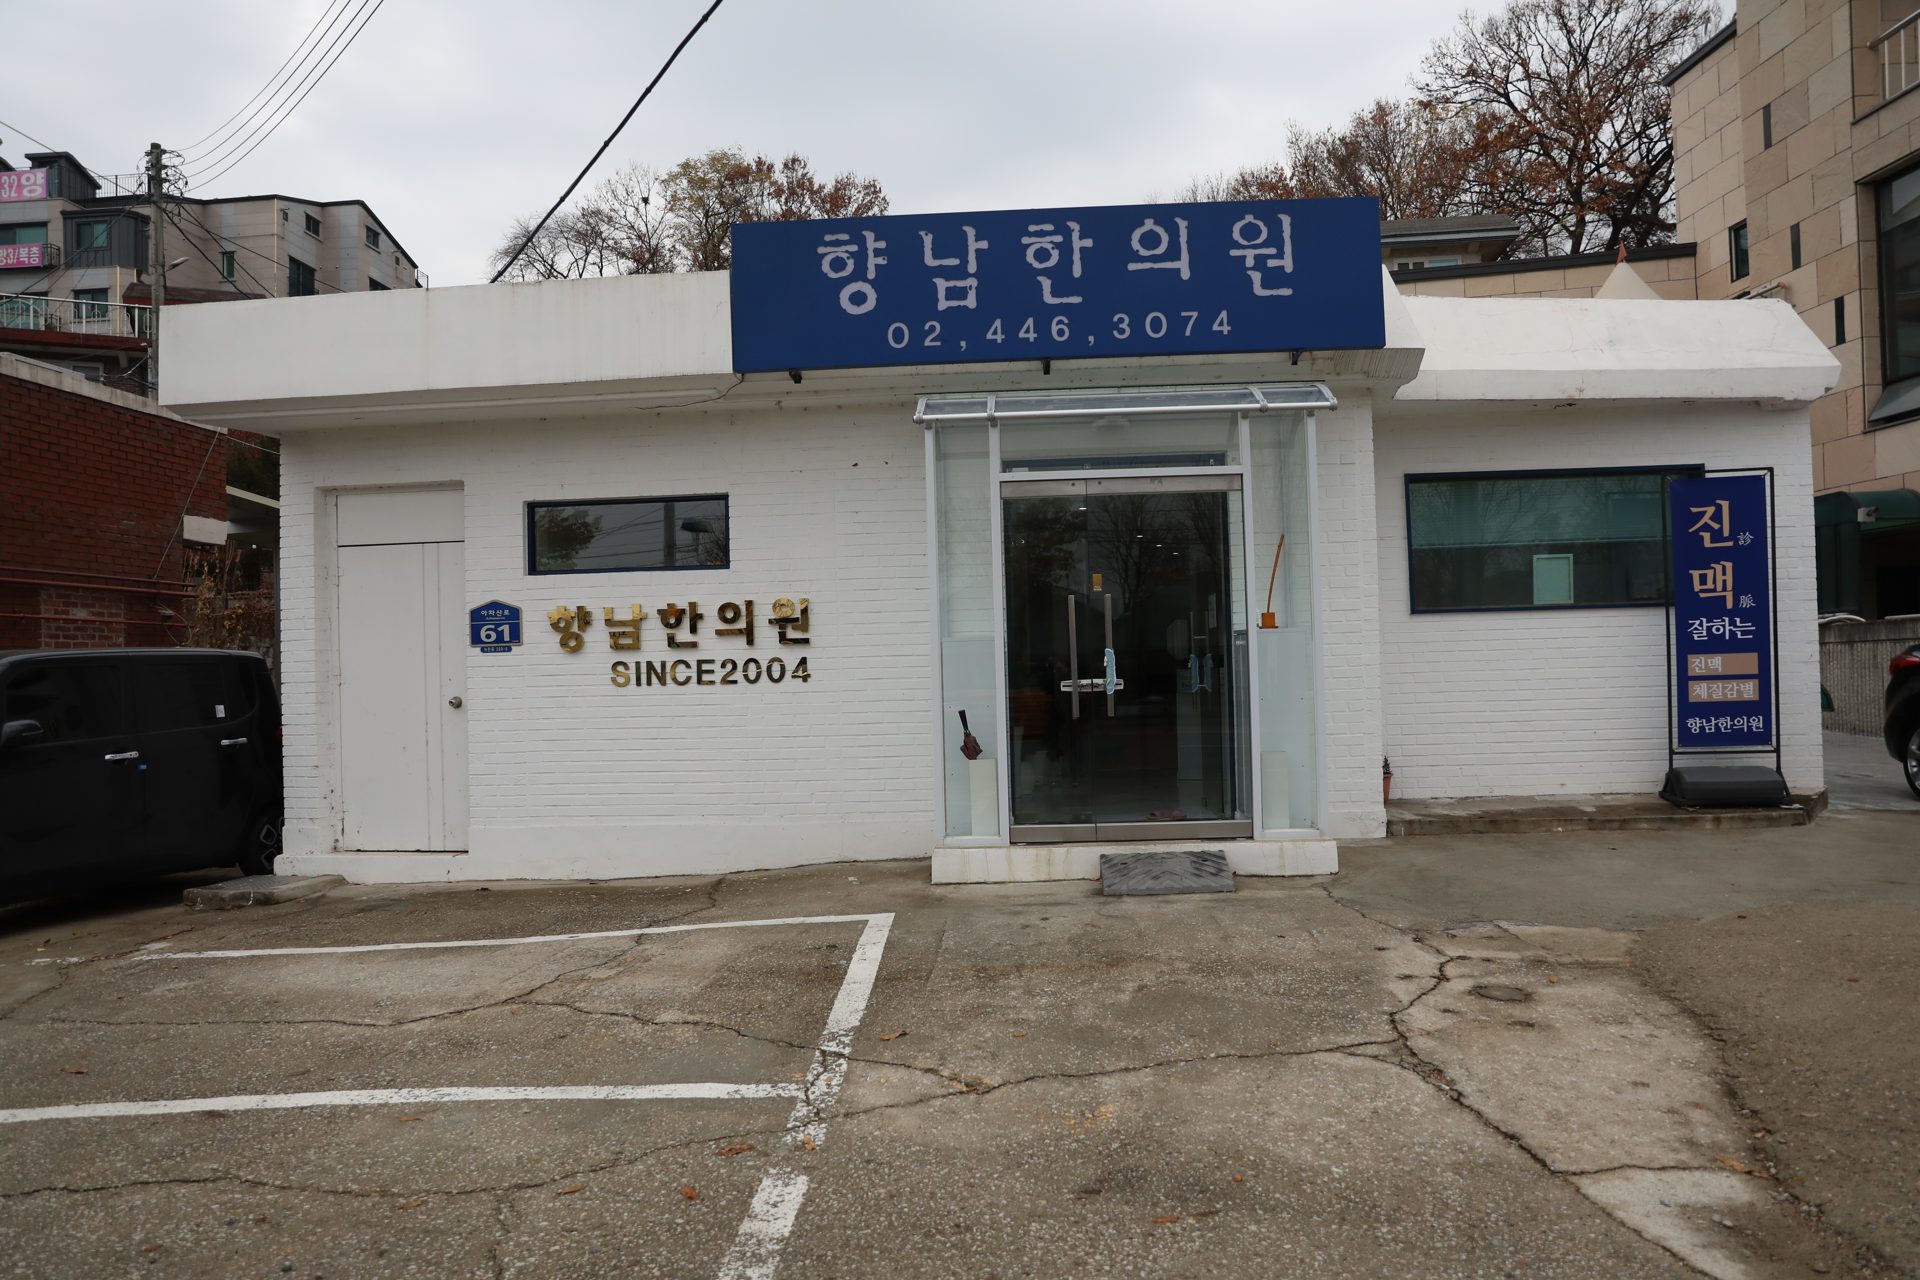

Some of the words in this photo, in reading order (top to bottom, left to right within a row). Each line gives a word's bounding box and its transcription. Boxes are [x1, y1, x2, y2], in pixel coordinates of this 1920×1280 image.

[817, 213, 1294, 316] 향남한의원
[479, 624, 511, 645] 61
[546, 597, 811, 653] 향남한의원
[1687, 616, 1756, 640] 잘하는
[1691, 656, 1722, 672] 진맥
[1692, 682, 1754, 699] 체질감별
[1686, 715, 1764, 734] 향남한의원
